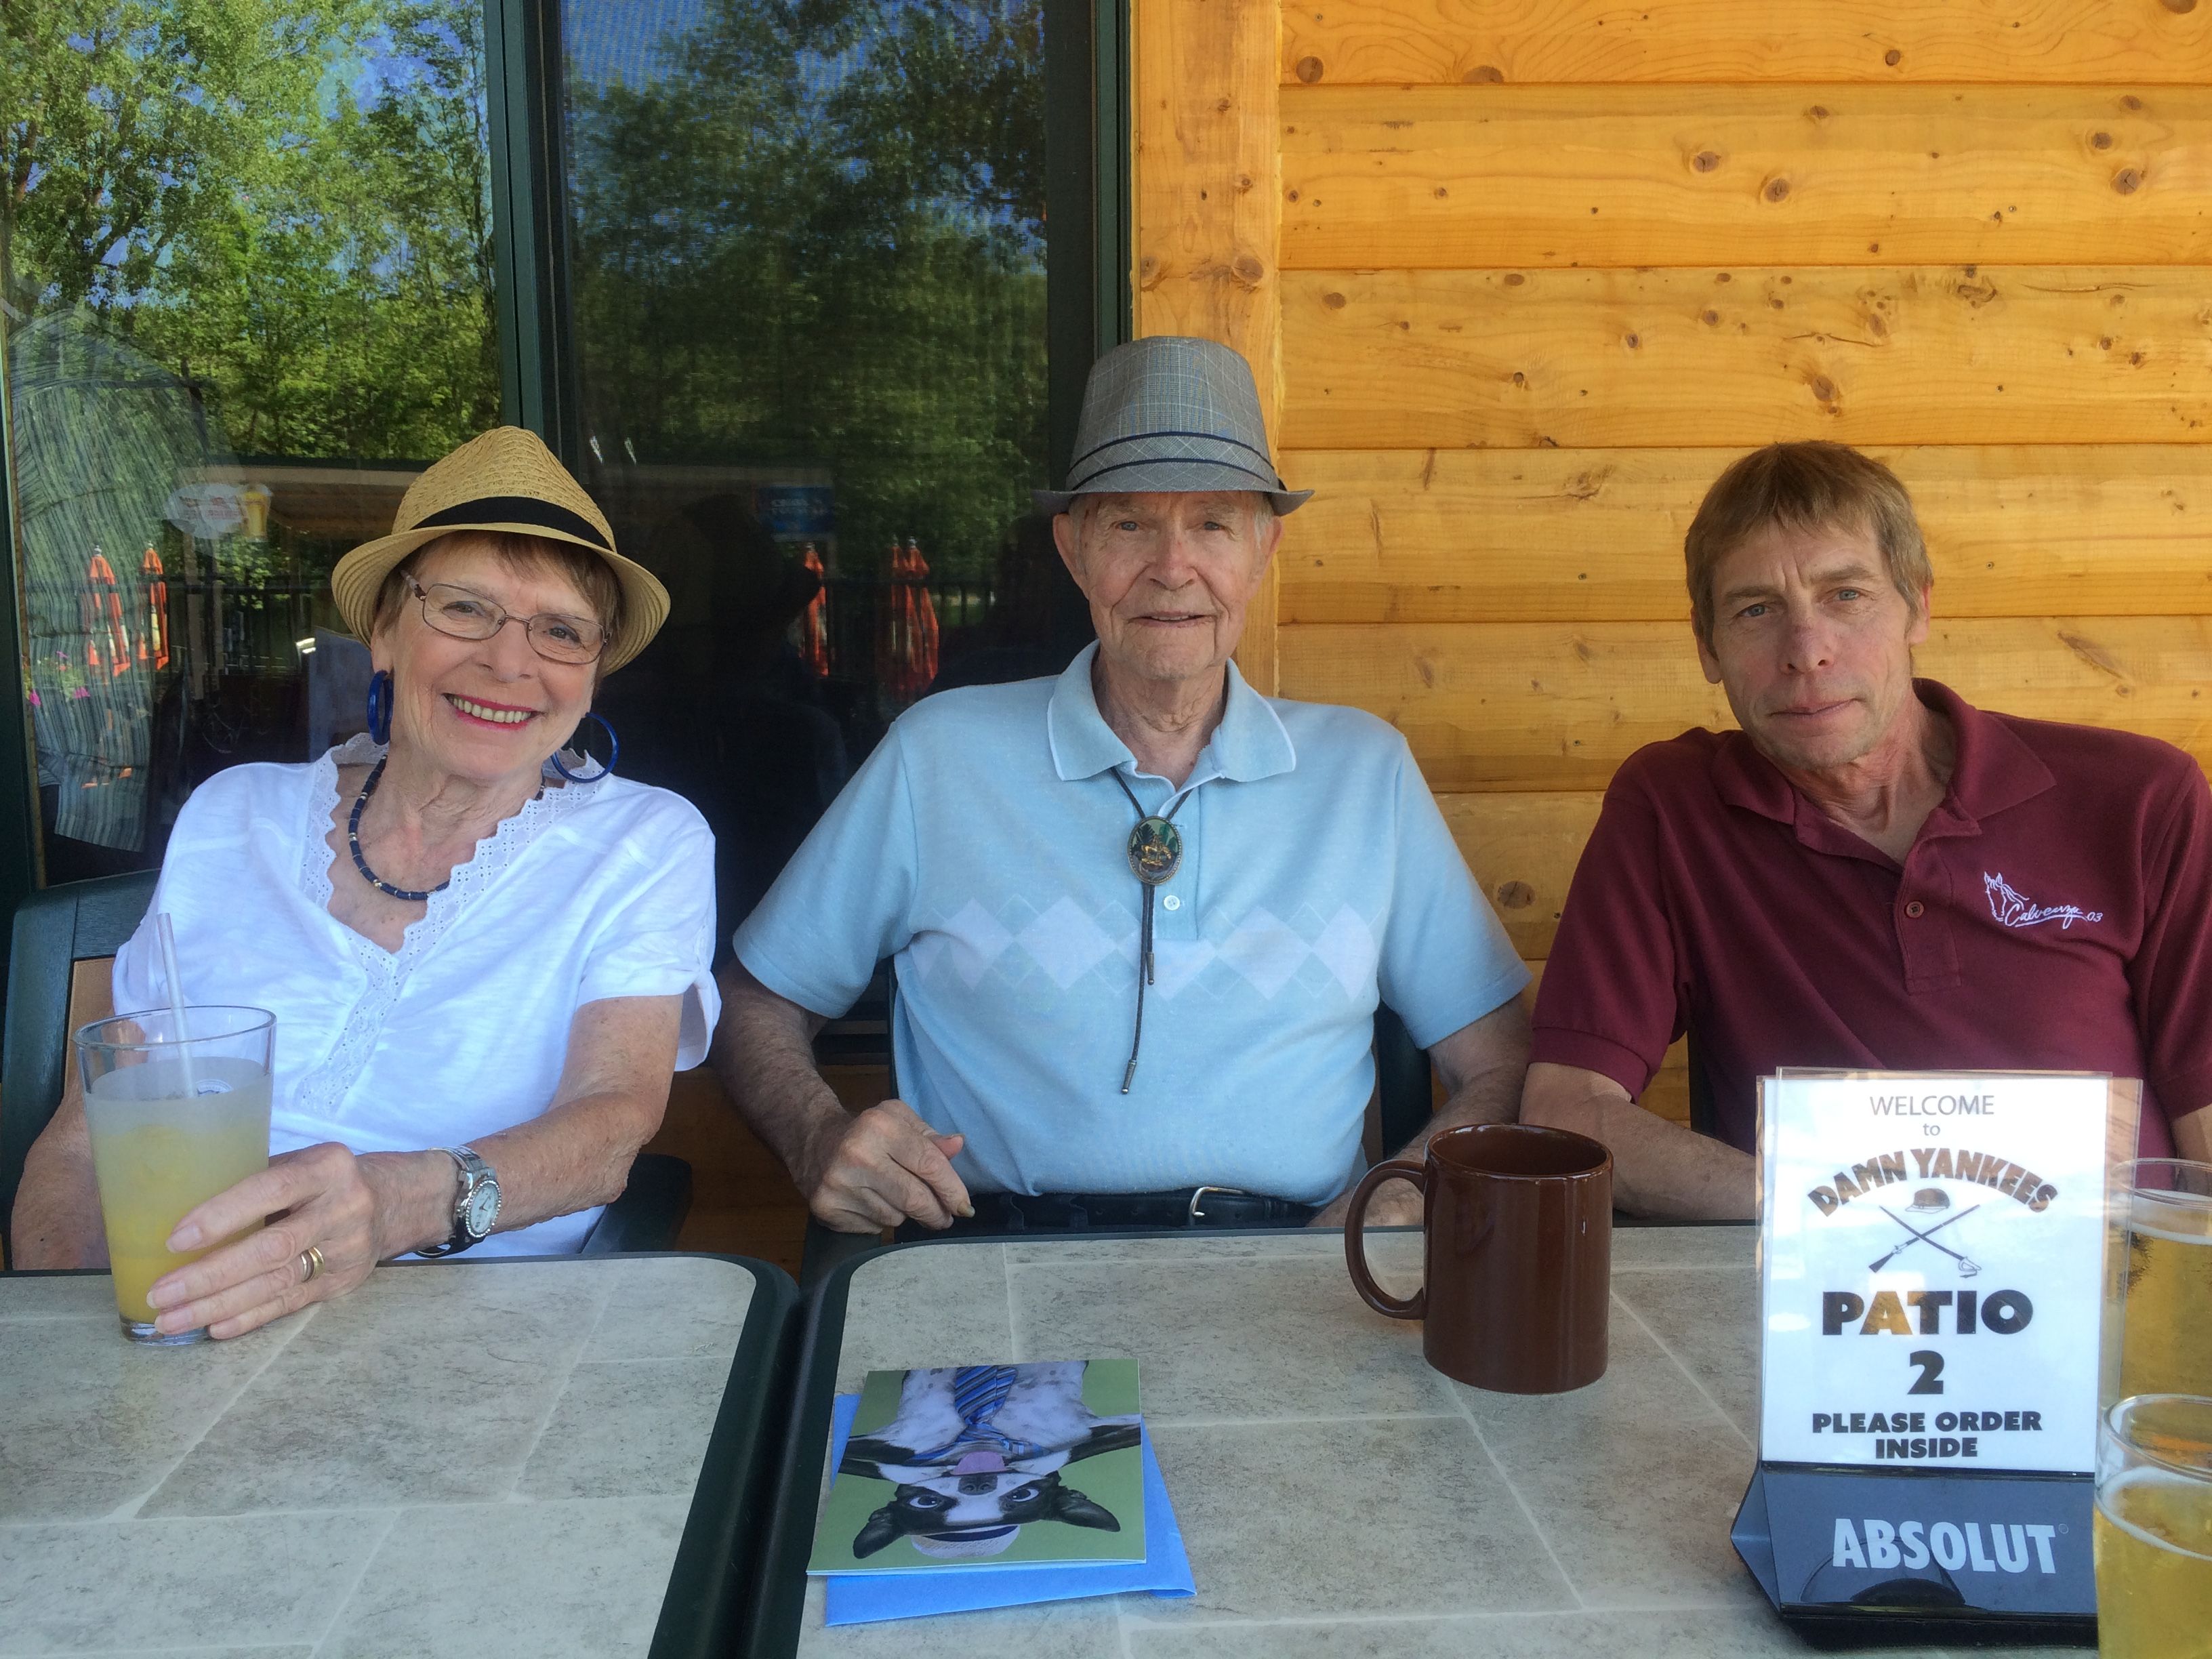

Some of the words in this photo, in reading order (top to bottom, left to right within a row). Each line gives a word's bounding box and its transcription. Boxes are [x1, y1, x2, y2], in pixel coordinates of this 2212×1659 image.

[1869, 1094, 1995, 1116] WELCOME
[1923, 1123, 1941, 1136] to
[1807, 1150, 1908, 1218] DAMN
[1910, 1147, 2059, 1213] YANKEES
[1822, 1289, 2034, 1336] PATIO
[1906, 1349, 1945, 1395] 2
[1812, 1412, 1926, 1434] PLEASE
[1935, 1410, 2043, 1433] ORDER
[1875, 1437, 1978, 1459] INSIDE
[1832, 1518, 2057, 1574] ABSOLUT
